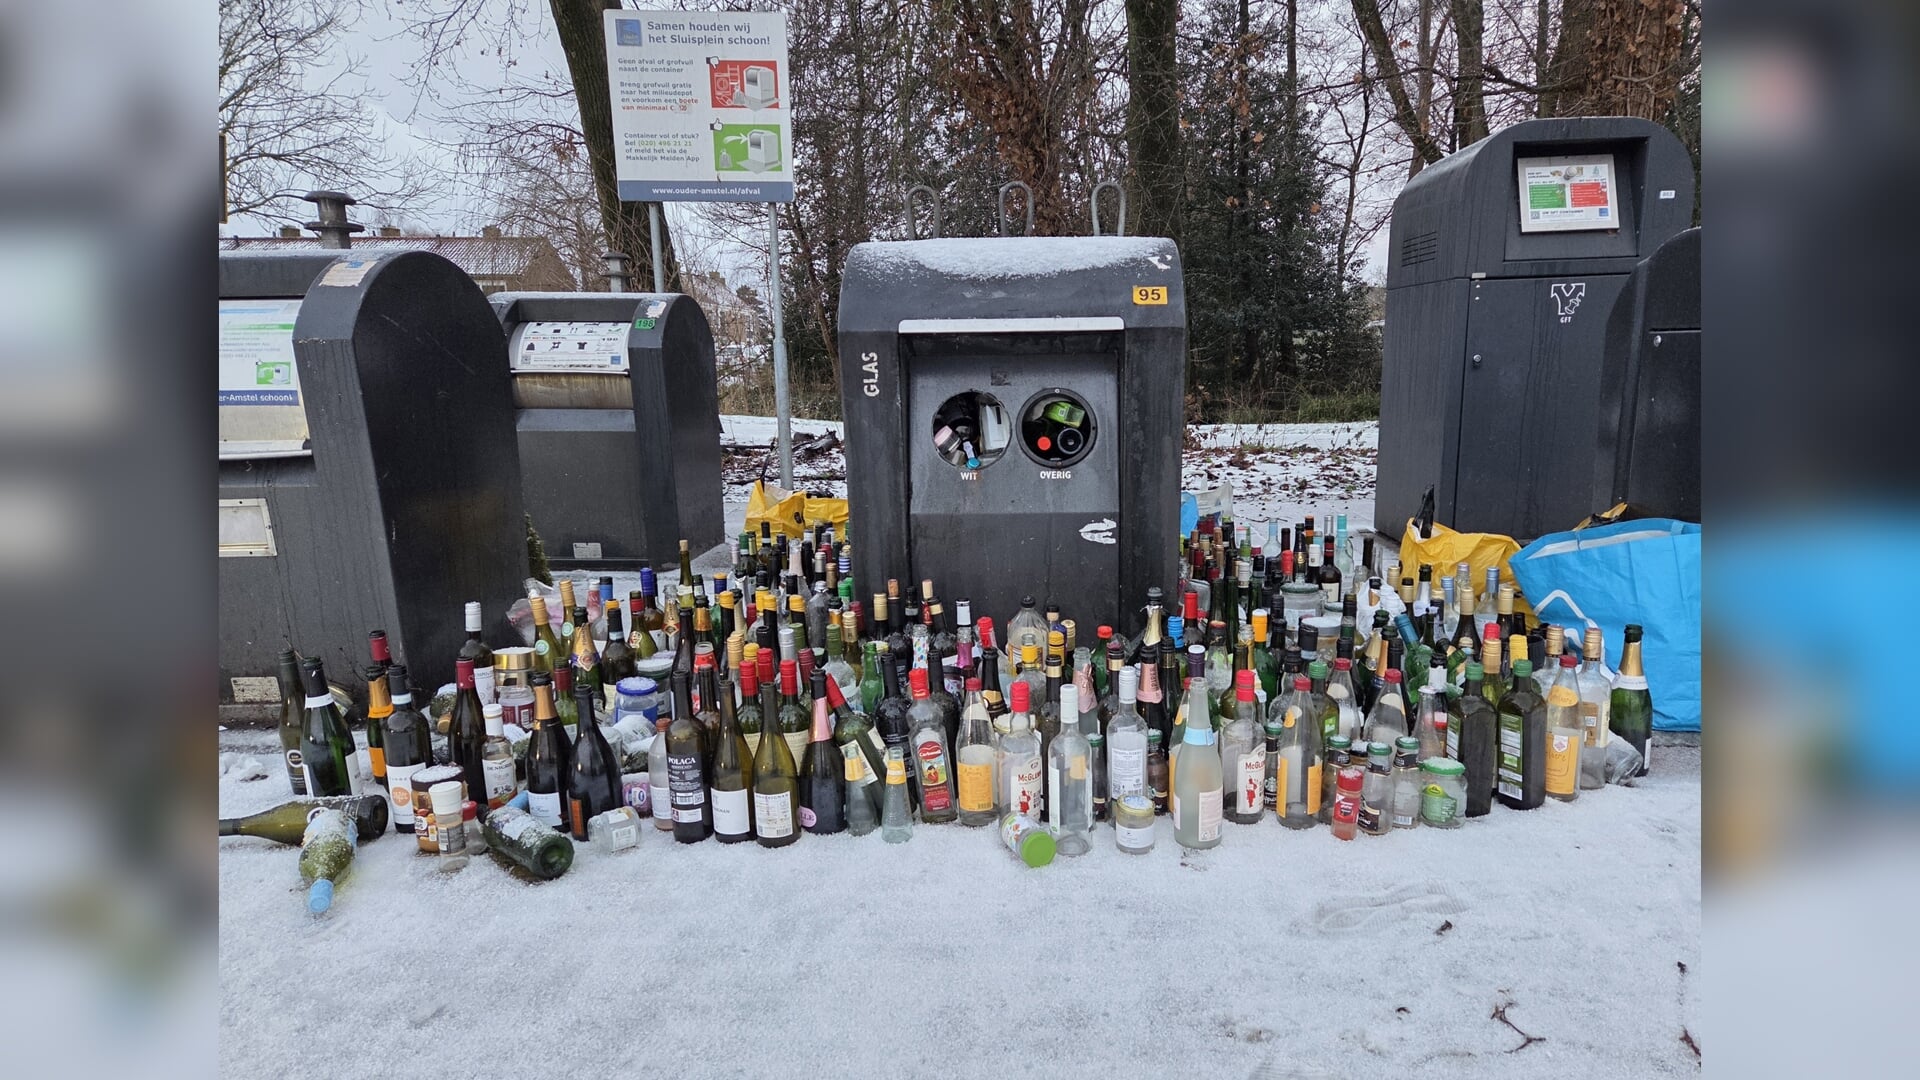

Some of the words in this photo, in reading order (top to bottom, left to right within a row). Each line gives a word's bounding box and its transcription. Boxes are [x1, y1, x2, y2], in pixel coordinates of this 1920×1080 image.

[647, 21, 685, 31] Samen
[689, 22, 731, 31] houden
[734, 23, 751, 34] wij
[648, 34, 666, 43] het
[670, 35, 724, 46] Sluisplein
[728, 36, 771, 45] schoon!
[651, 187, 761, 196] www.ouder-amstel.nl/afval
[1138, 288, 1161, 301] 95
[861, 352, 880, 397] GLAS
[960, 472, 979, 480] WIT
[1040, 470, 1072, 480] OVERIG
